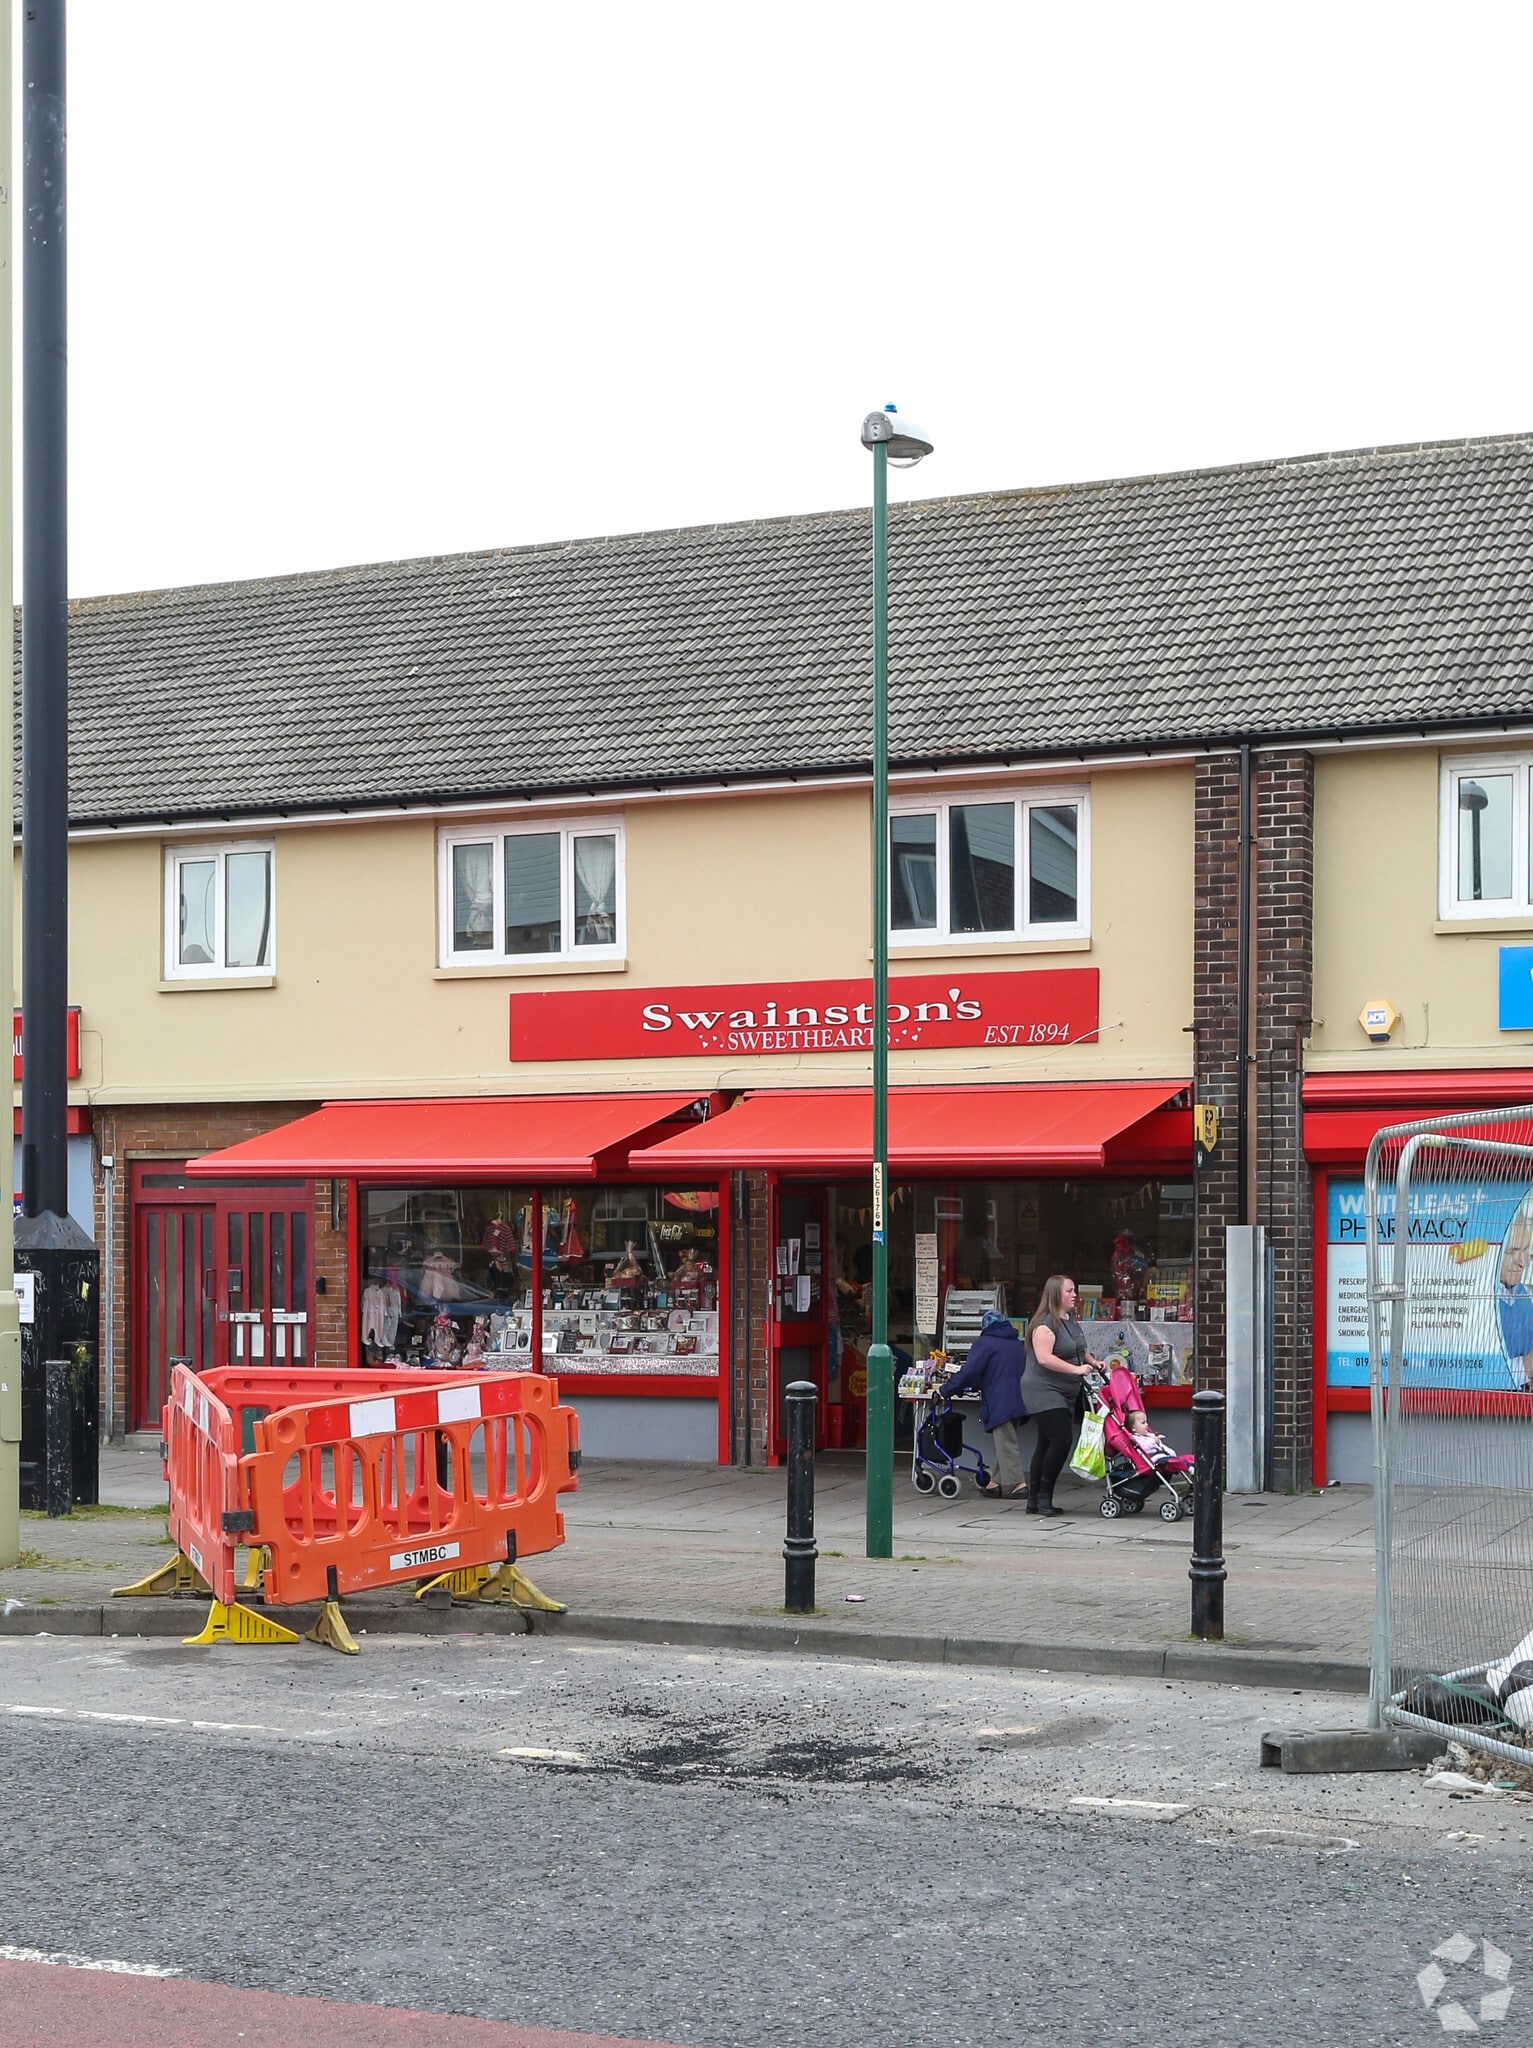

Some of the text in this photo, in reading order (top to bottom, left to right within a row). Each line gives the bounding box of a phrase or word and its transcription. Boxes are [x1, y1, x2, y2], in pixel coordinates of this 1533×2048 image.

[642, 988, 982, 1031] Swainston's
[983, 1023, 1070, 1044] EST 1894
[1340, 1218, 1468, 1239] PHARMACY
[1338, 1329, 1366, 1337] SMOKING
[403, 1546, 447, 1566] STMBC
